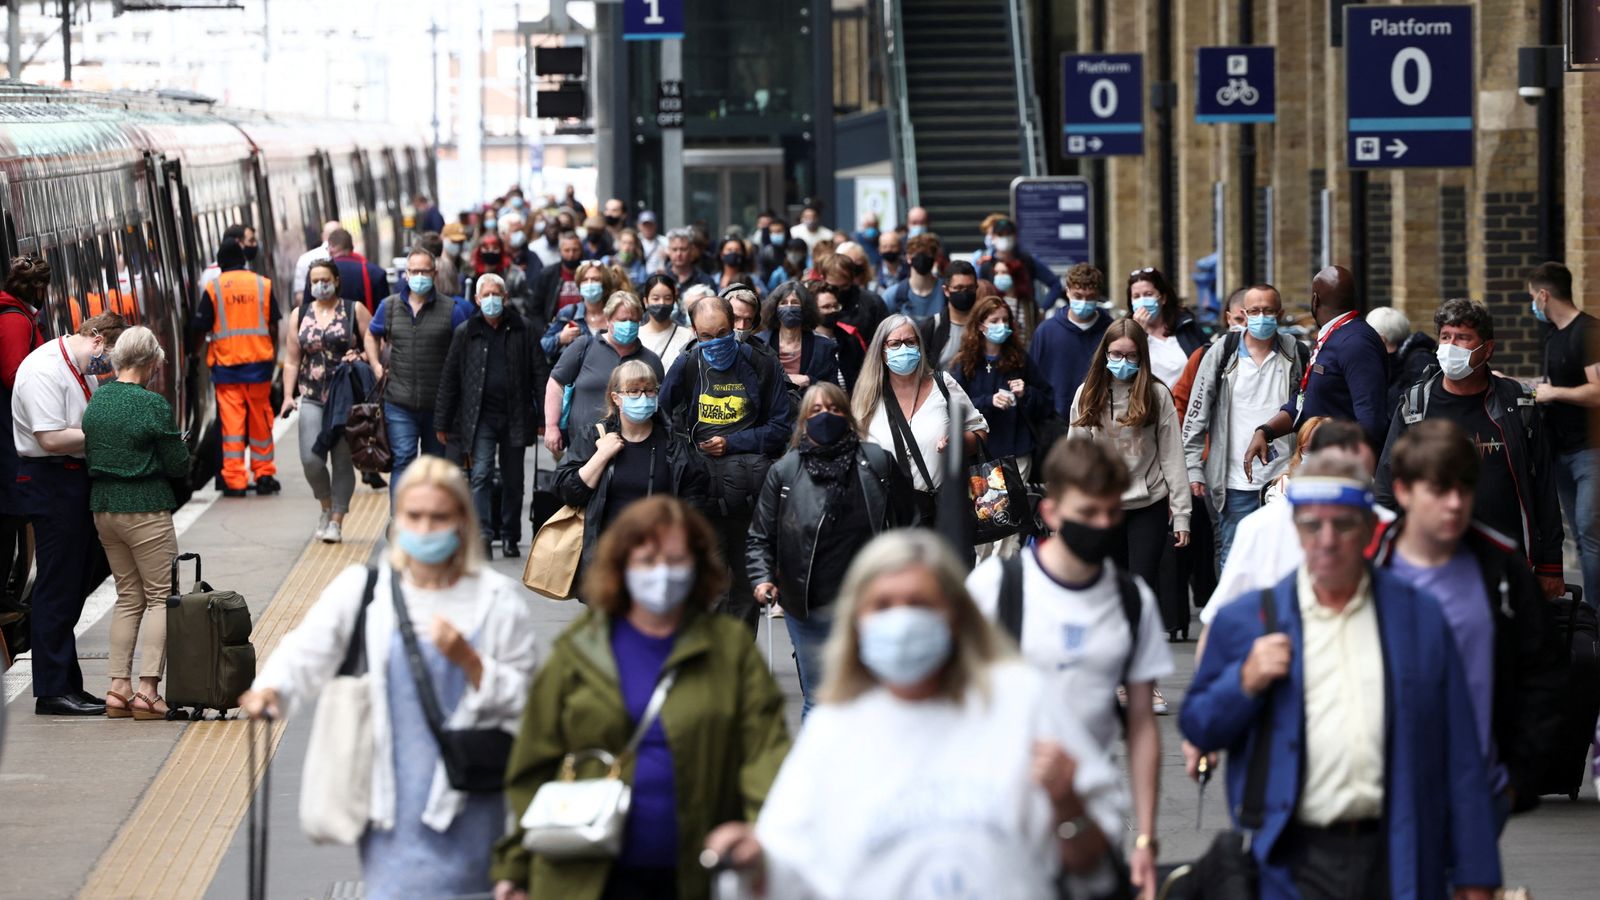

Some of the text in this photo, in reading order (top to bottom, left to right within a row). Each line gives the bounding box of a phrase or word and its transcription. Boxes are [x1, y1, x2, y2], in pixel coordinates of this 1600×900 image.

[643, 0, 665, 25] 1
[1370, 17, 1453, 36] Platform
[1077, 60, 1131, 74] Platform
[1390, 46, 1433, 106] 0
[1089, 78, 1119, 118] 0
[225, 294, 256, 305] LNER
